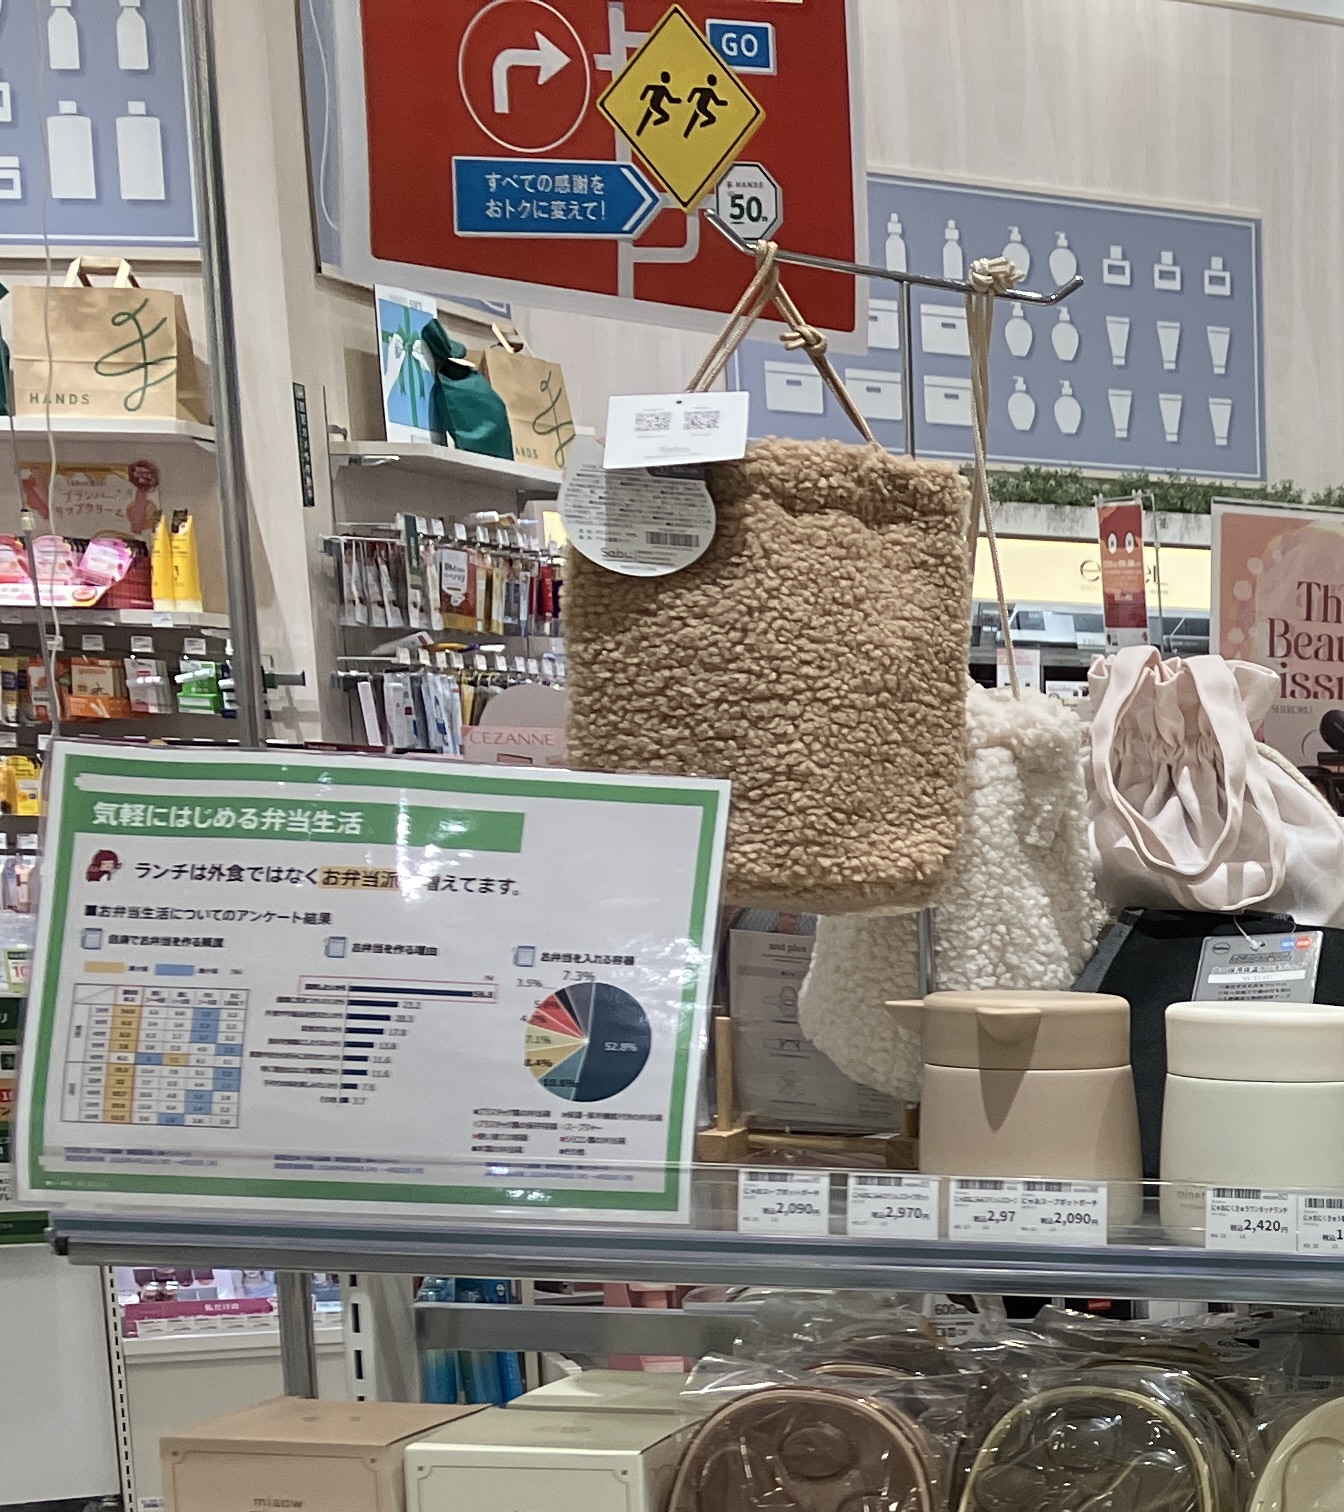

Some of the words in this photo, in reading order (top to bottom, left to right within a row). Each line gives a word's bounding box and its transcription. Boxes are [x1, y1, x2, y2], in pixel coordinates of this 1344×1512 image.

[720, 32, 759, 57] GO
[484, 172, 605, 196] すべての感謝を
[29, 391, 91, 406] HANDS
[514, 446, 539, 459] ANDS
[469, 731, 556, 747] CEZANNE
[92, 802, 364, 836] 気軽にはじめる弁当生活
[1230, 1219, 1289, 1234] 税込2,420円
[253, 1497, 304, 1509] miaow
